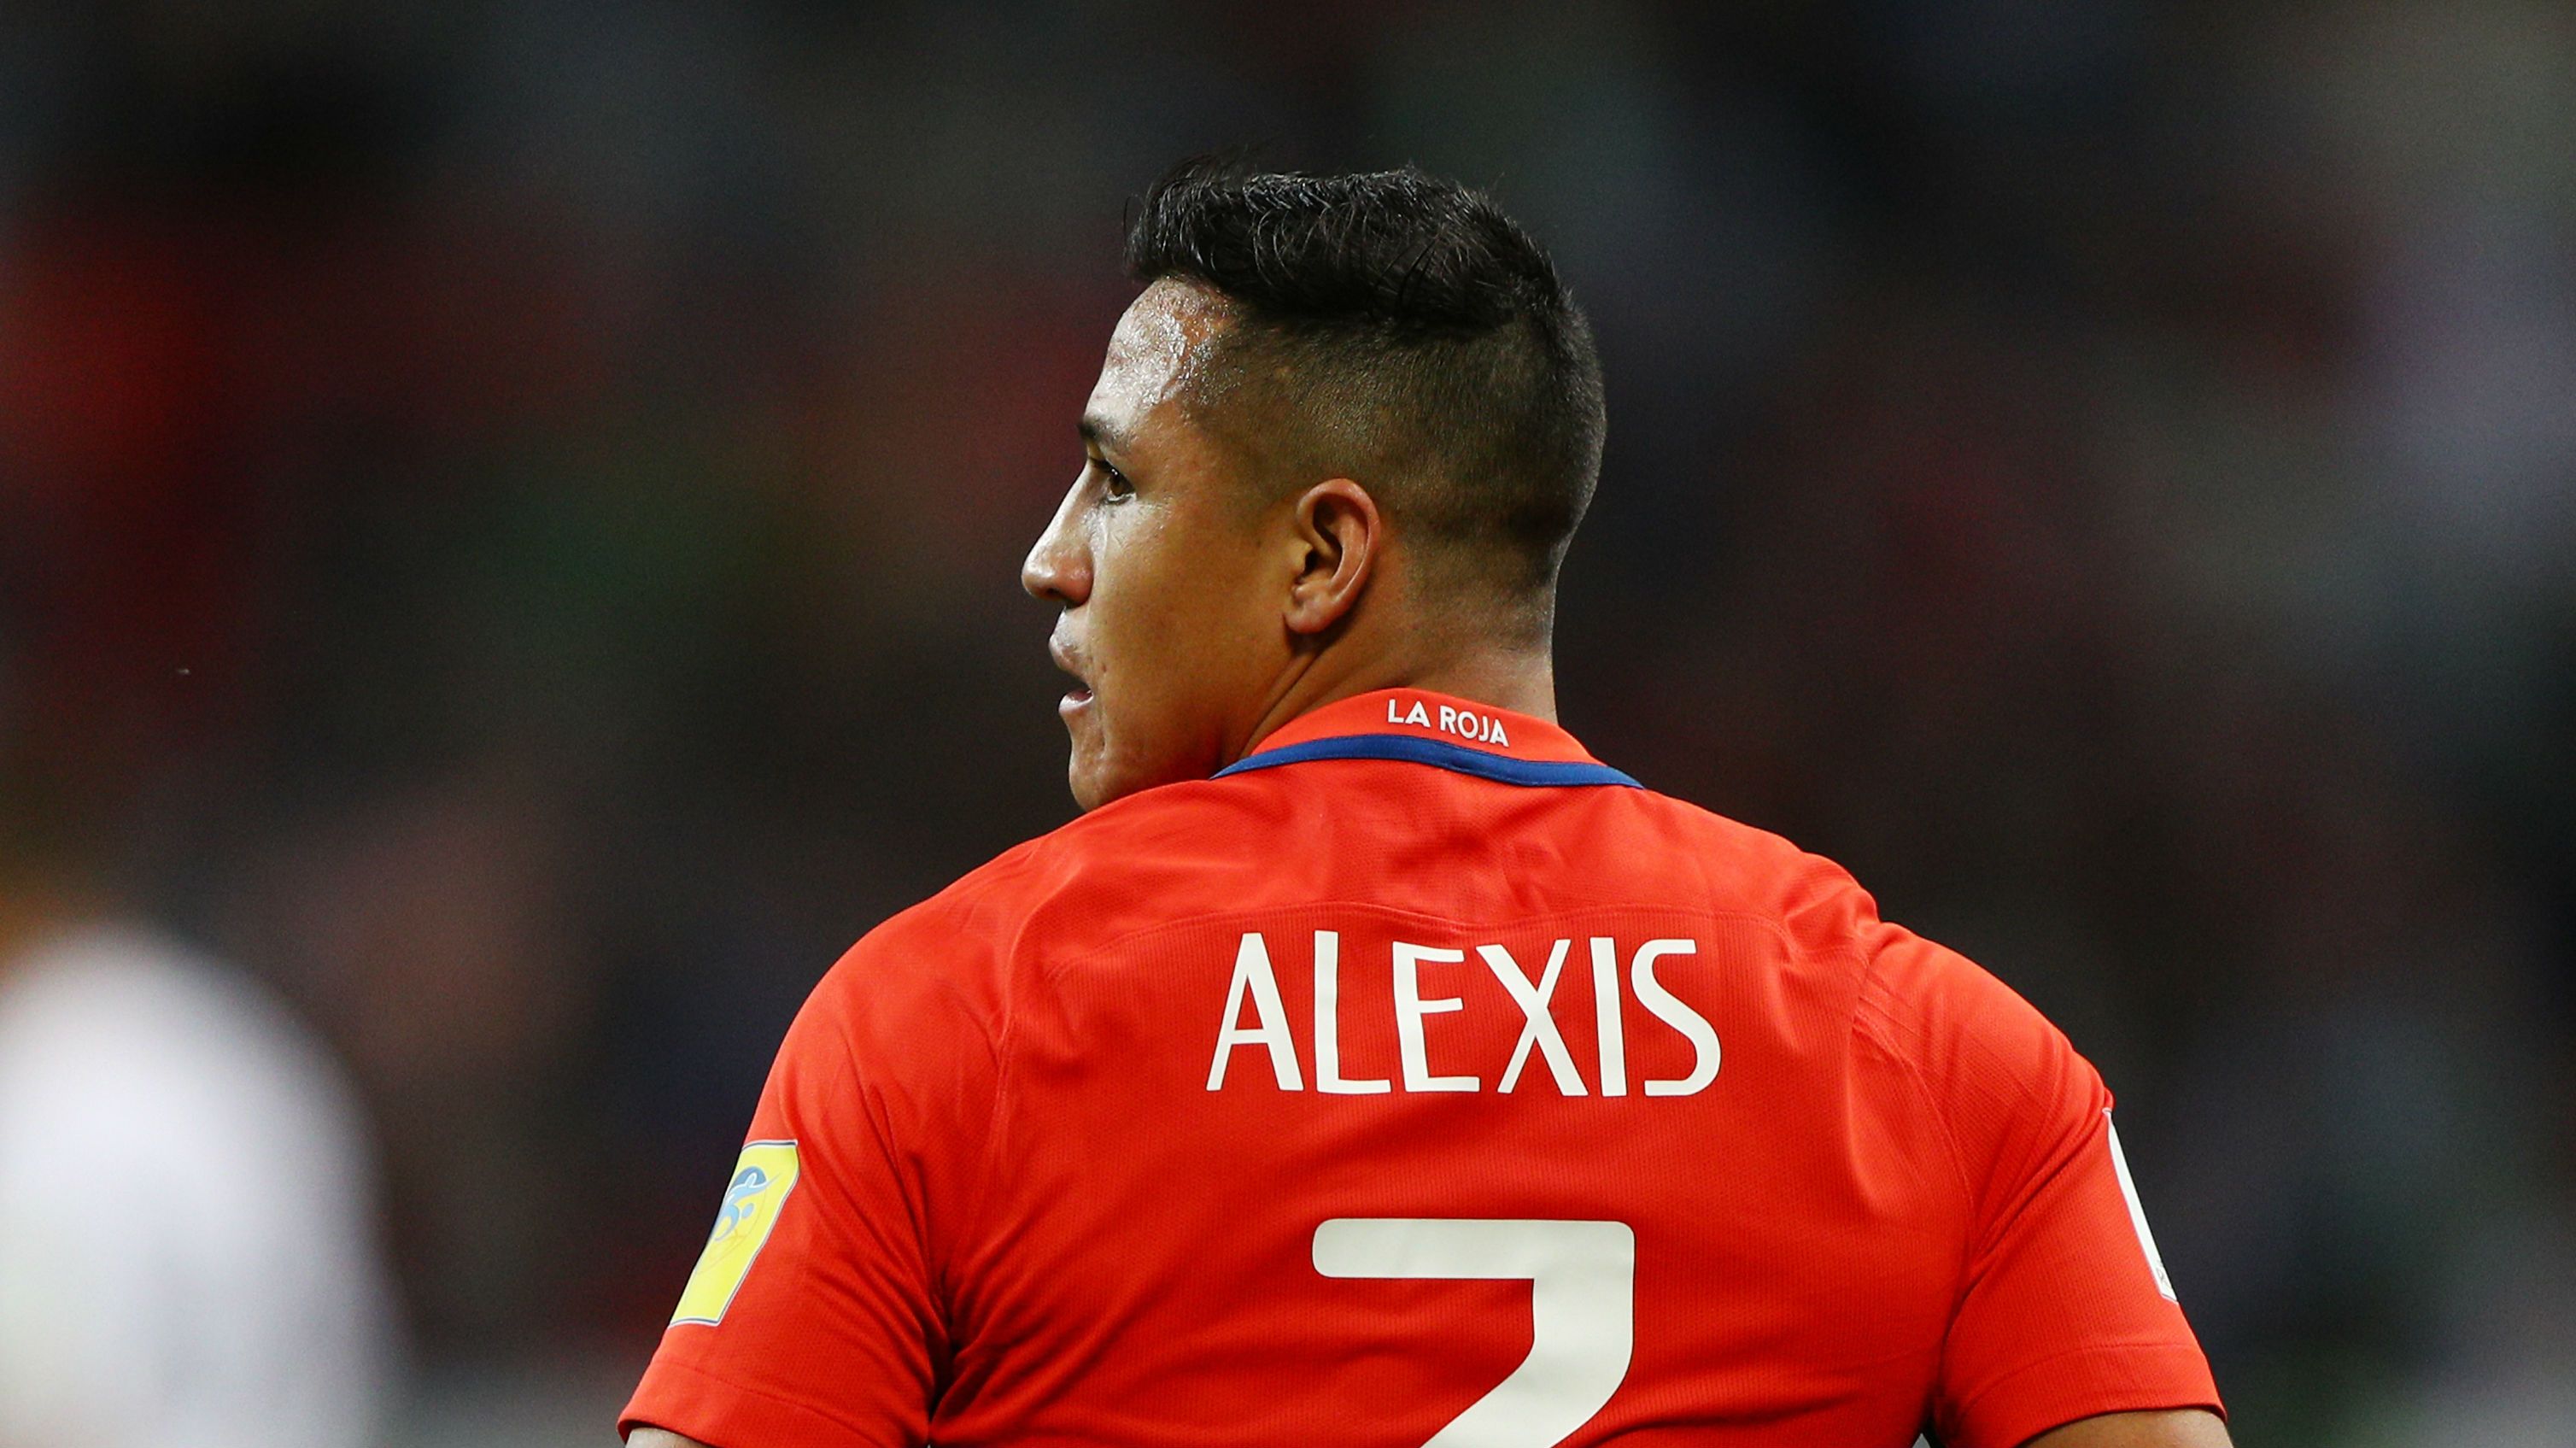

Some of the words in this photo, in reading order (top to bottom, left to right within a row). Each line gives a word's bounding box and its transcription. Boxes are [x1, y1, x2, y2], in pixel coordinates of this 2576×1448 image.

[1387, 699, 1431, 728] LA
[1439, 706, 1509, 747] ROJA
[1206, 929, 1721, 1098] ALEXIS
